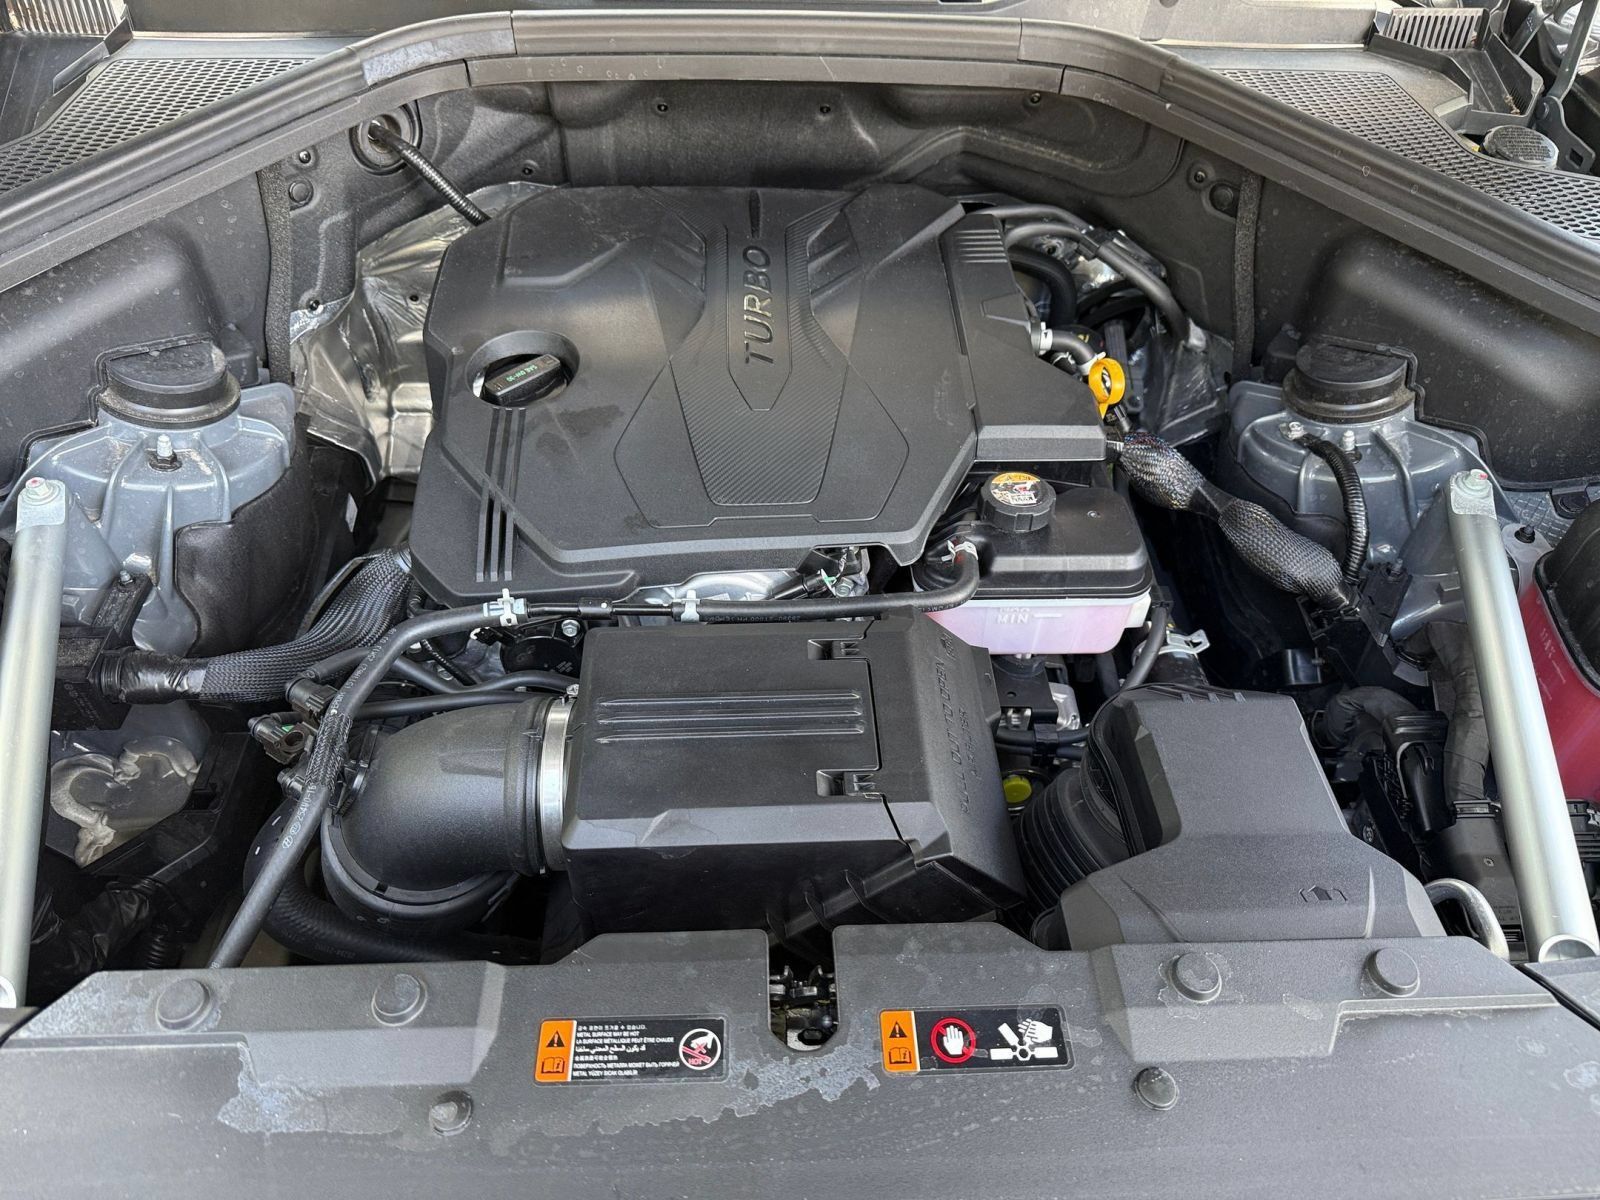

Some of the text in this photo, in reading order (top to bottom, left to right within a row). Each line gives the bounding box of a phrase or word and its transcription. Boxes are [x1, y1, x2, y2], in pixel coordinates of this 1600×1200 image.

[742, 245, 774, 364] TURBO
[997, 613, 1029, 624] MIN
[935, 656, 950, 700] OPEN
[943, 702, 954, 724] TO
[947, 728, 962, 765] OUT
